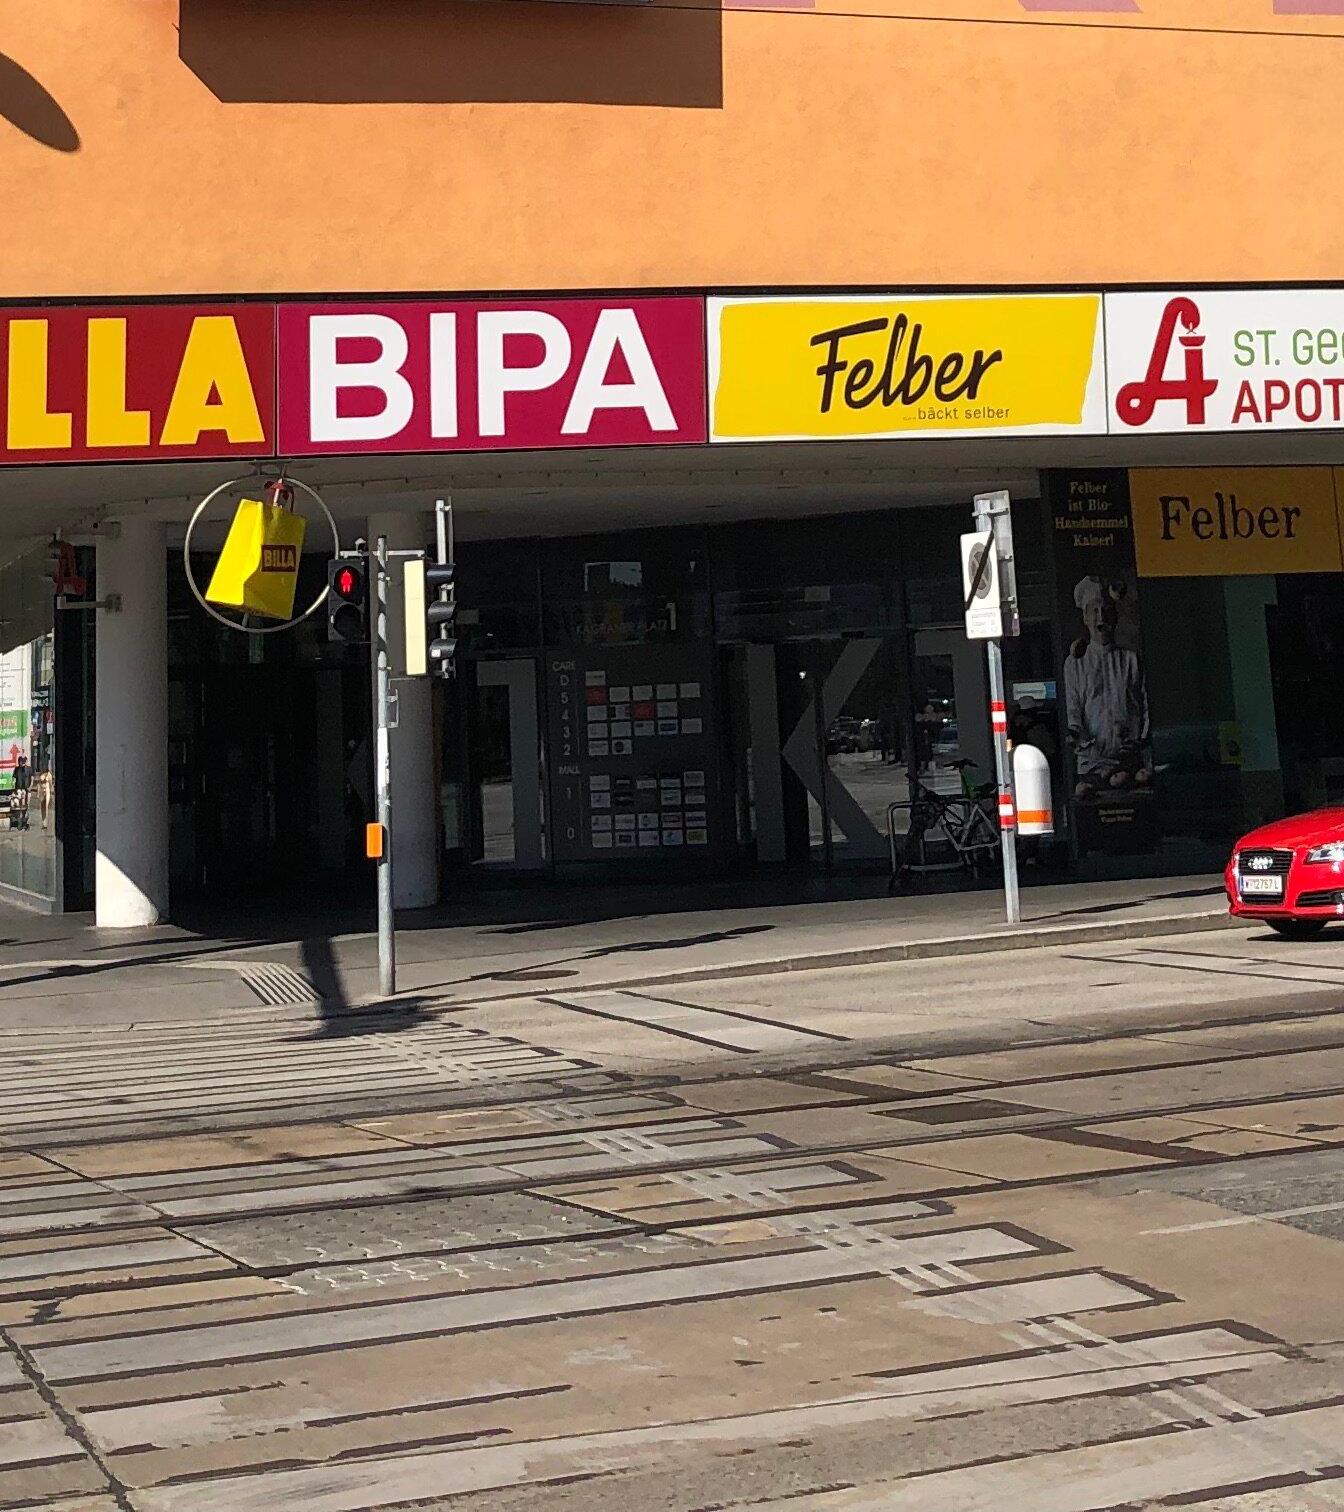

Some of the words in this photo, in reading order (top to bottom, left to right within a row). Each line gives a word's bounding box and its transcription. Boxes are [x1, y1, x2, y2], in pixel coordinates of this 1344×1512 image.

[810, 313, 1003, 413] Felber
[1234, 330, 1282, 366] ST.
[310, 308, 680, 442] BIPA
[964, 405, 1011, 420] selber
[1159, 495, 1301, 541] Felber
[263, 545, 296, 570] BILLA
